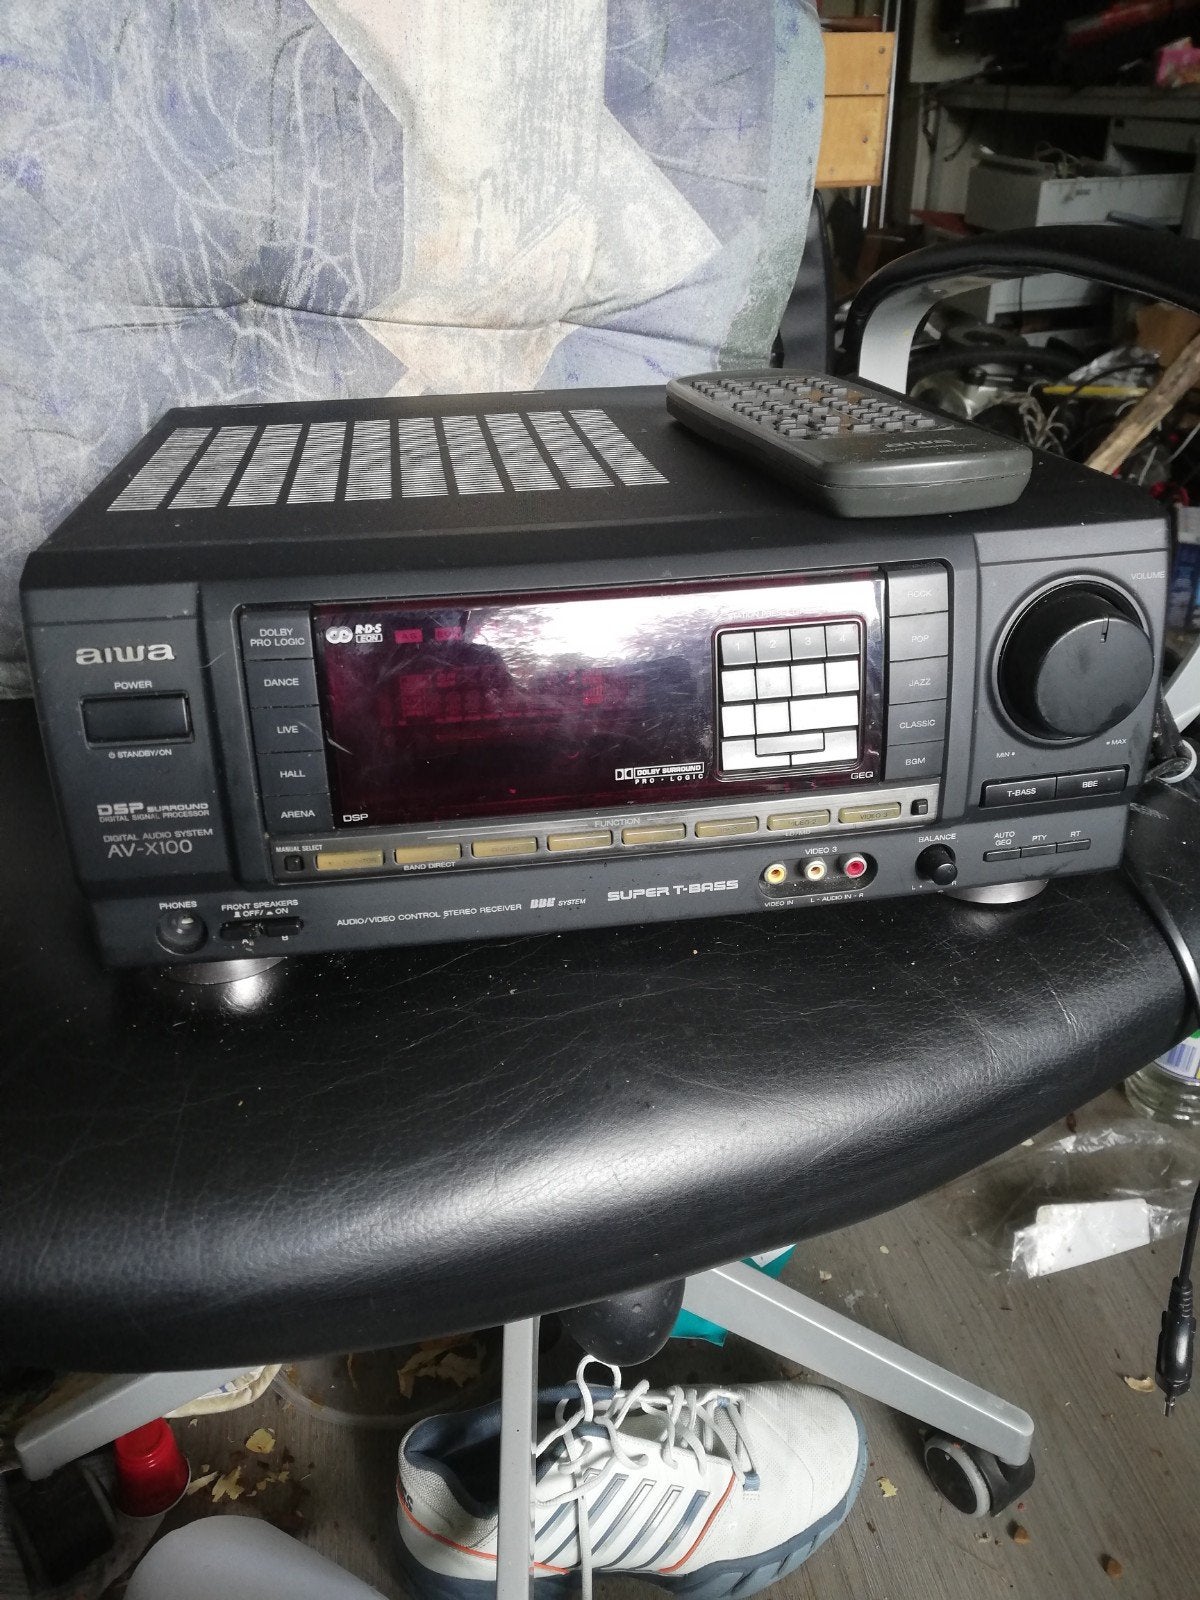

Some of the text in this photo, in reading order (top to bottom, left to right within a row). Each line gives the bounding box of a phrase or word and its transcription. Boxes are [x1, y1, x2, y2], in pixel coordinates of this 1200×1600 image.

[1131, 571, 1166, 580] VOLUME
[907, 590, 932, 598] ROCK
[259, 628, 294, 638] DOLBY
[250, 637, 305, 647] PRO LOGIC
[804, 637, 812, 646] 3
[839, 634, 846, 643] 4
[911, 634, 929, 643] POP
[769, 640, 777, 649] 2
[76, 643, 175, 665] aiwa
[114, 681, 153, 690] POWER
[263, 678, 300, 687] DANCE
[908, 677, 931, 687] JAZZ
[899, 719, 936, 729] CLASSIC
[276, 725, 299, 734] LIVE
[1111, 738, 1127, 746] MAX
[117, 749, 172, 759] STANDBY/ON
[905, 756, 926, 766] BGM
[279, 769, 306, 779] HALL
[636, 764, 702, 776] DOLBY SURROUND
[634, 773, 704, 785] PRO LOGIC
[850, 771, 875, 780] GEQ
[1082, 780, 1098, 789] BBE
[1007, 787, 1036, 797] T-BASS
[97, 802, 209, 816] DSP SURROUND
[99, 810, 210, 823] DIGITAL SIGNAL PROCESSOR
[280, 810, 315, 819] ARENA
[342, 813, 369, 823] DSP
[860, 812, 881, 820] VIDEO
[594, 817, 641, 828] FUNCTION
[103, 828, 213, 842] DIGITAL AUDIO SYSTEM
[918, 833, 957, 843] BALANCE
[993, 831, 1015, 840] AUTO
[1031, 834, 1047, 842] PTY
[995, 838, 1012, 847] GEQ
[107, 839, 193, 858] AV-X100
[805, 847, 829, 855] VIDEO
[403, 861, 456, 871] BAND DIRECT
[607, 880, 739, 902] SUPER T-BASS
[558, 898, 586, 907] SYSTEM
[822, 894, 843, 902] AUDIO
[159, 900, 197, 910] PHONES
[221, 899, 299, 911] FRONT SPEAKERS
[337, 903, 522, 926] AUDIO/VIDEO CONTROL STEREO RECEIVER
